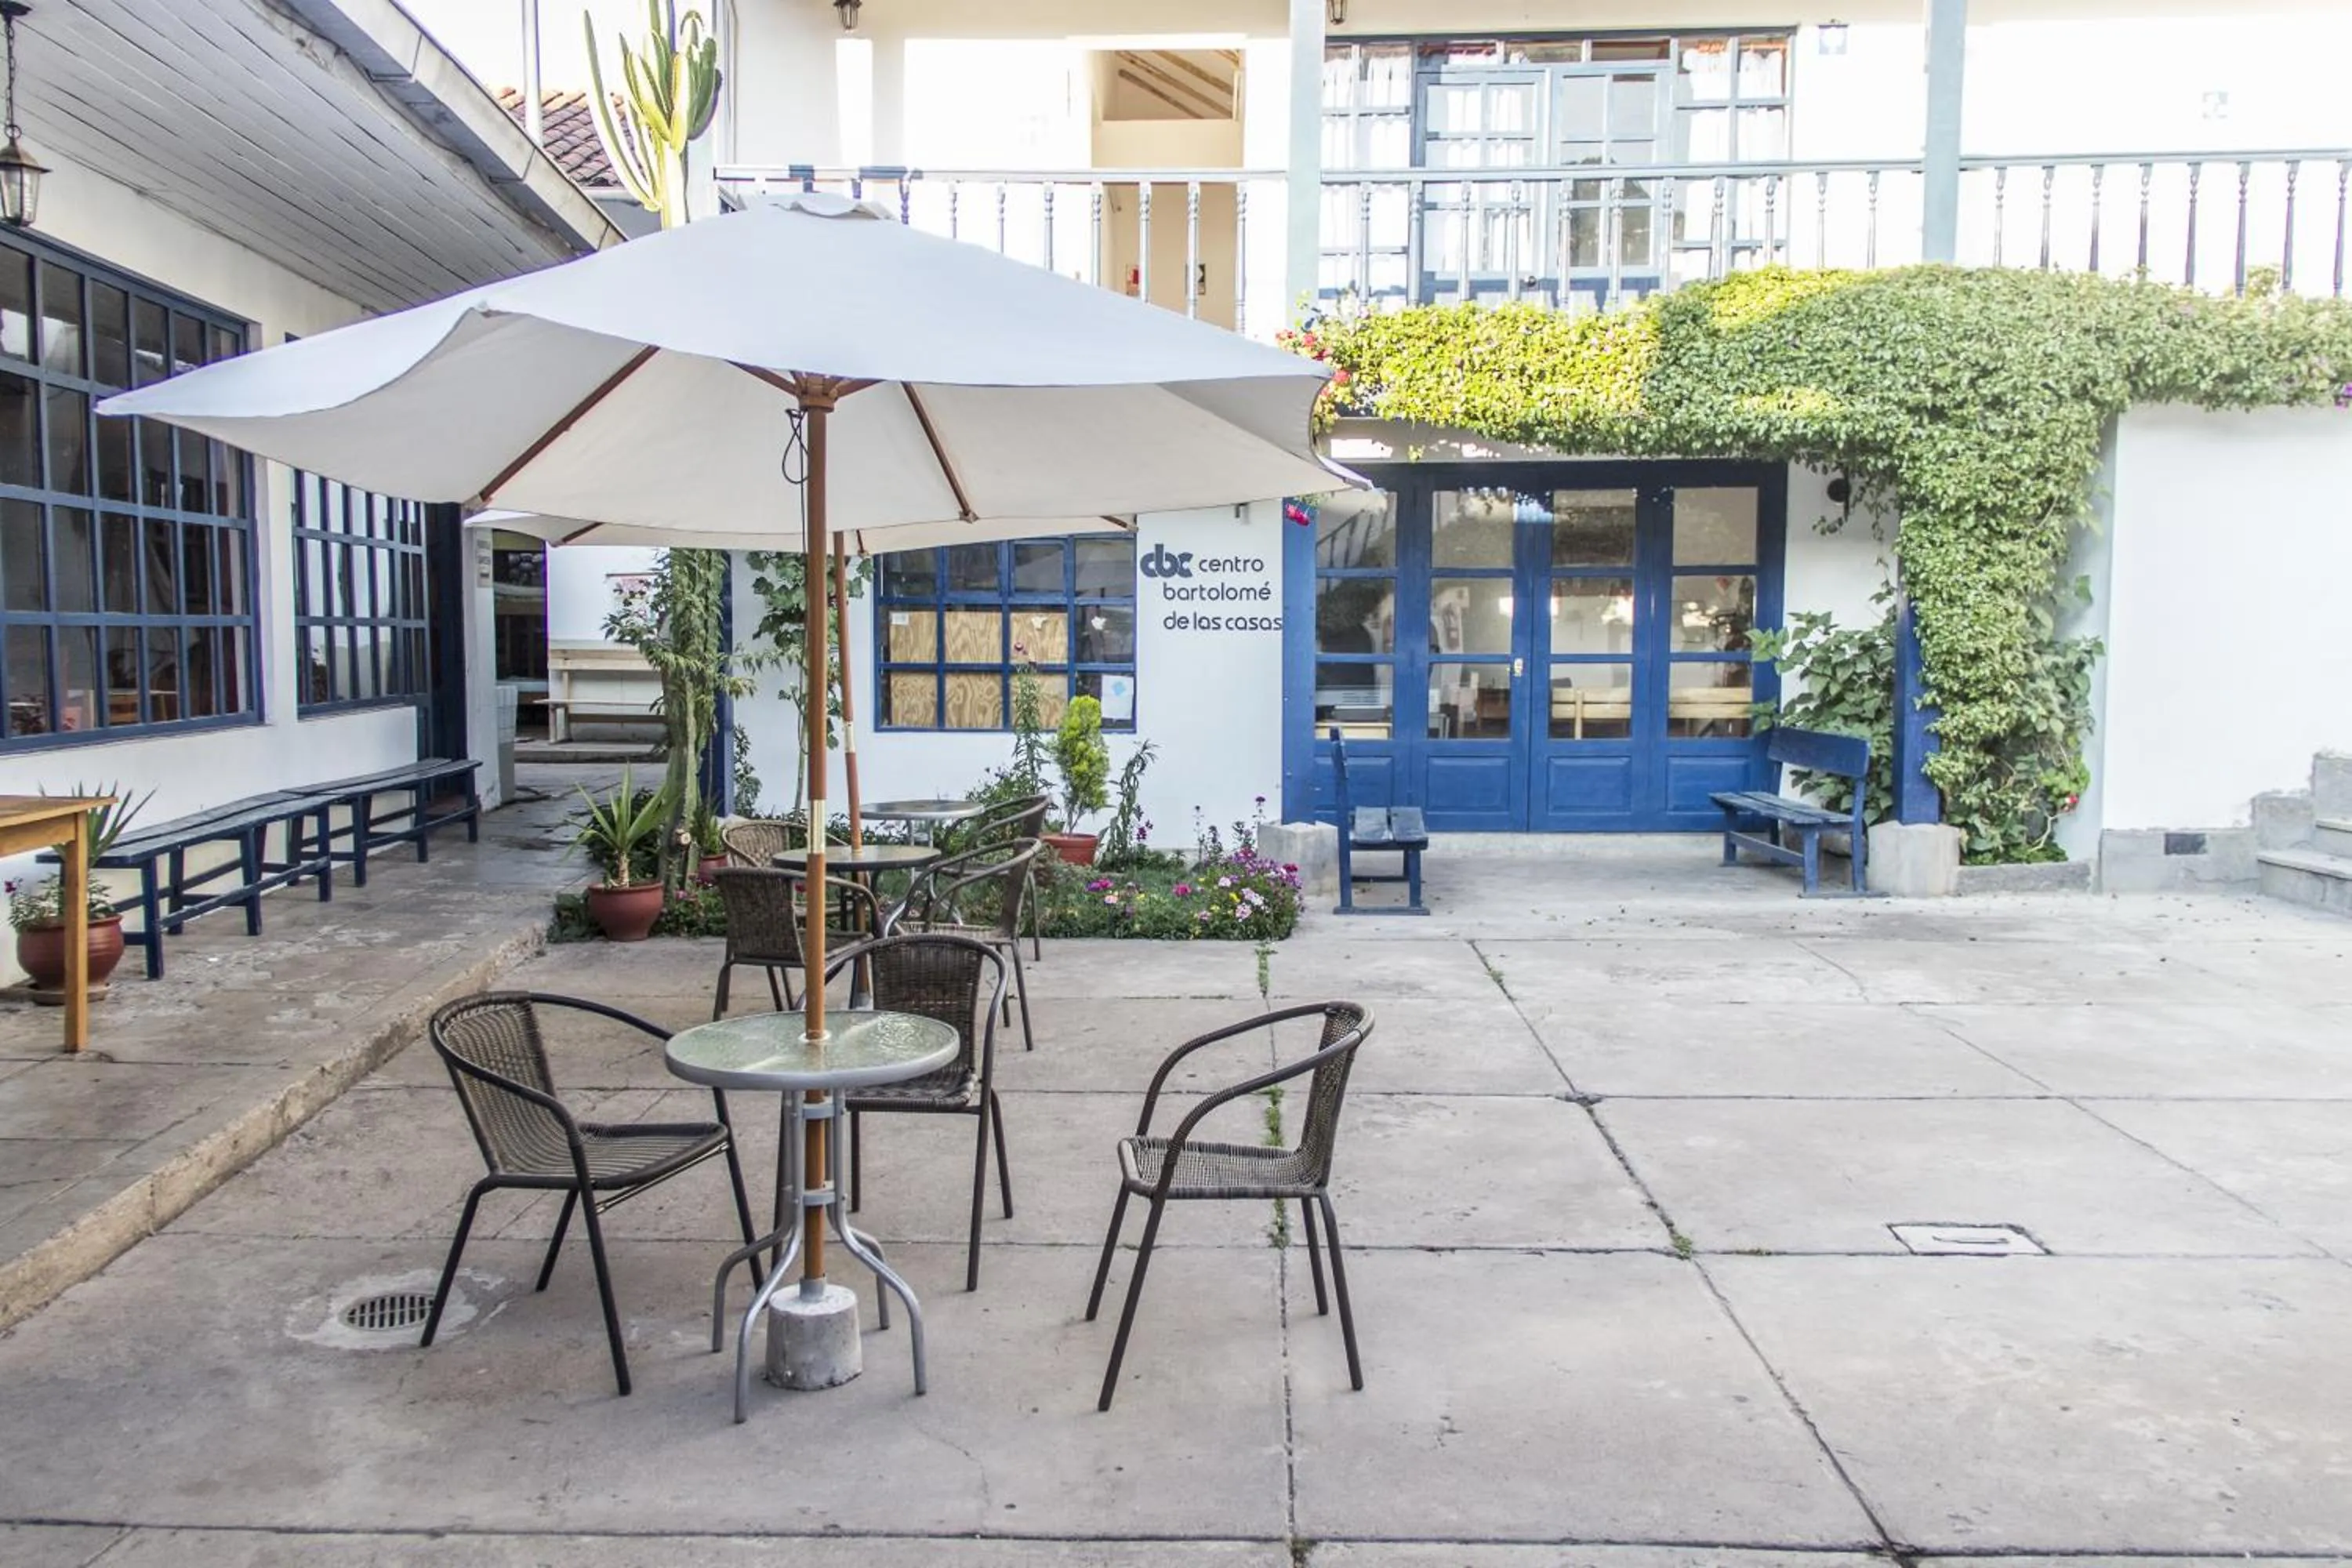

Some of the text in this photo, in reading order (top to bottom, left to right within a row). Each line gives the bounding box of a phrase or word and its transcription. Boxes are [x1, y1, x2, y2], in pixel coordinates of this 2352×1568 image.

[1139, 543, 1265, 579] cbc centro
[1163, 581, 1272, 601] bartolomé
[1163, 611, 1283, 631] de las casas
